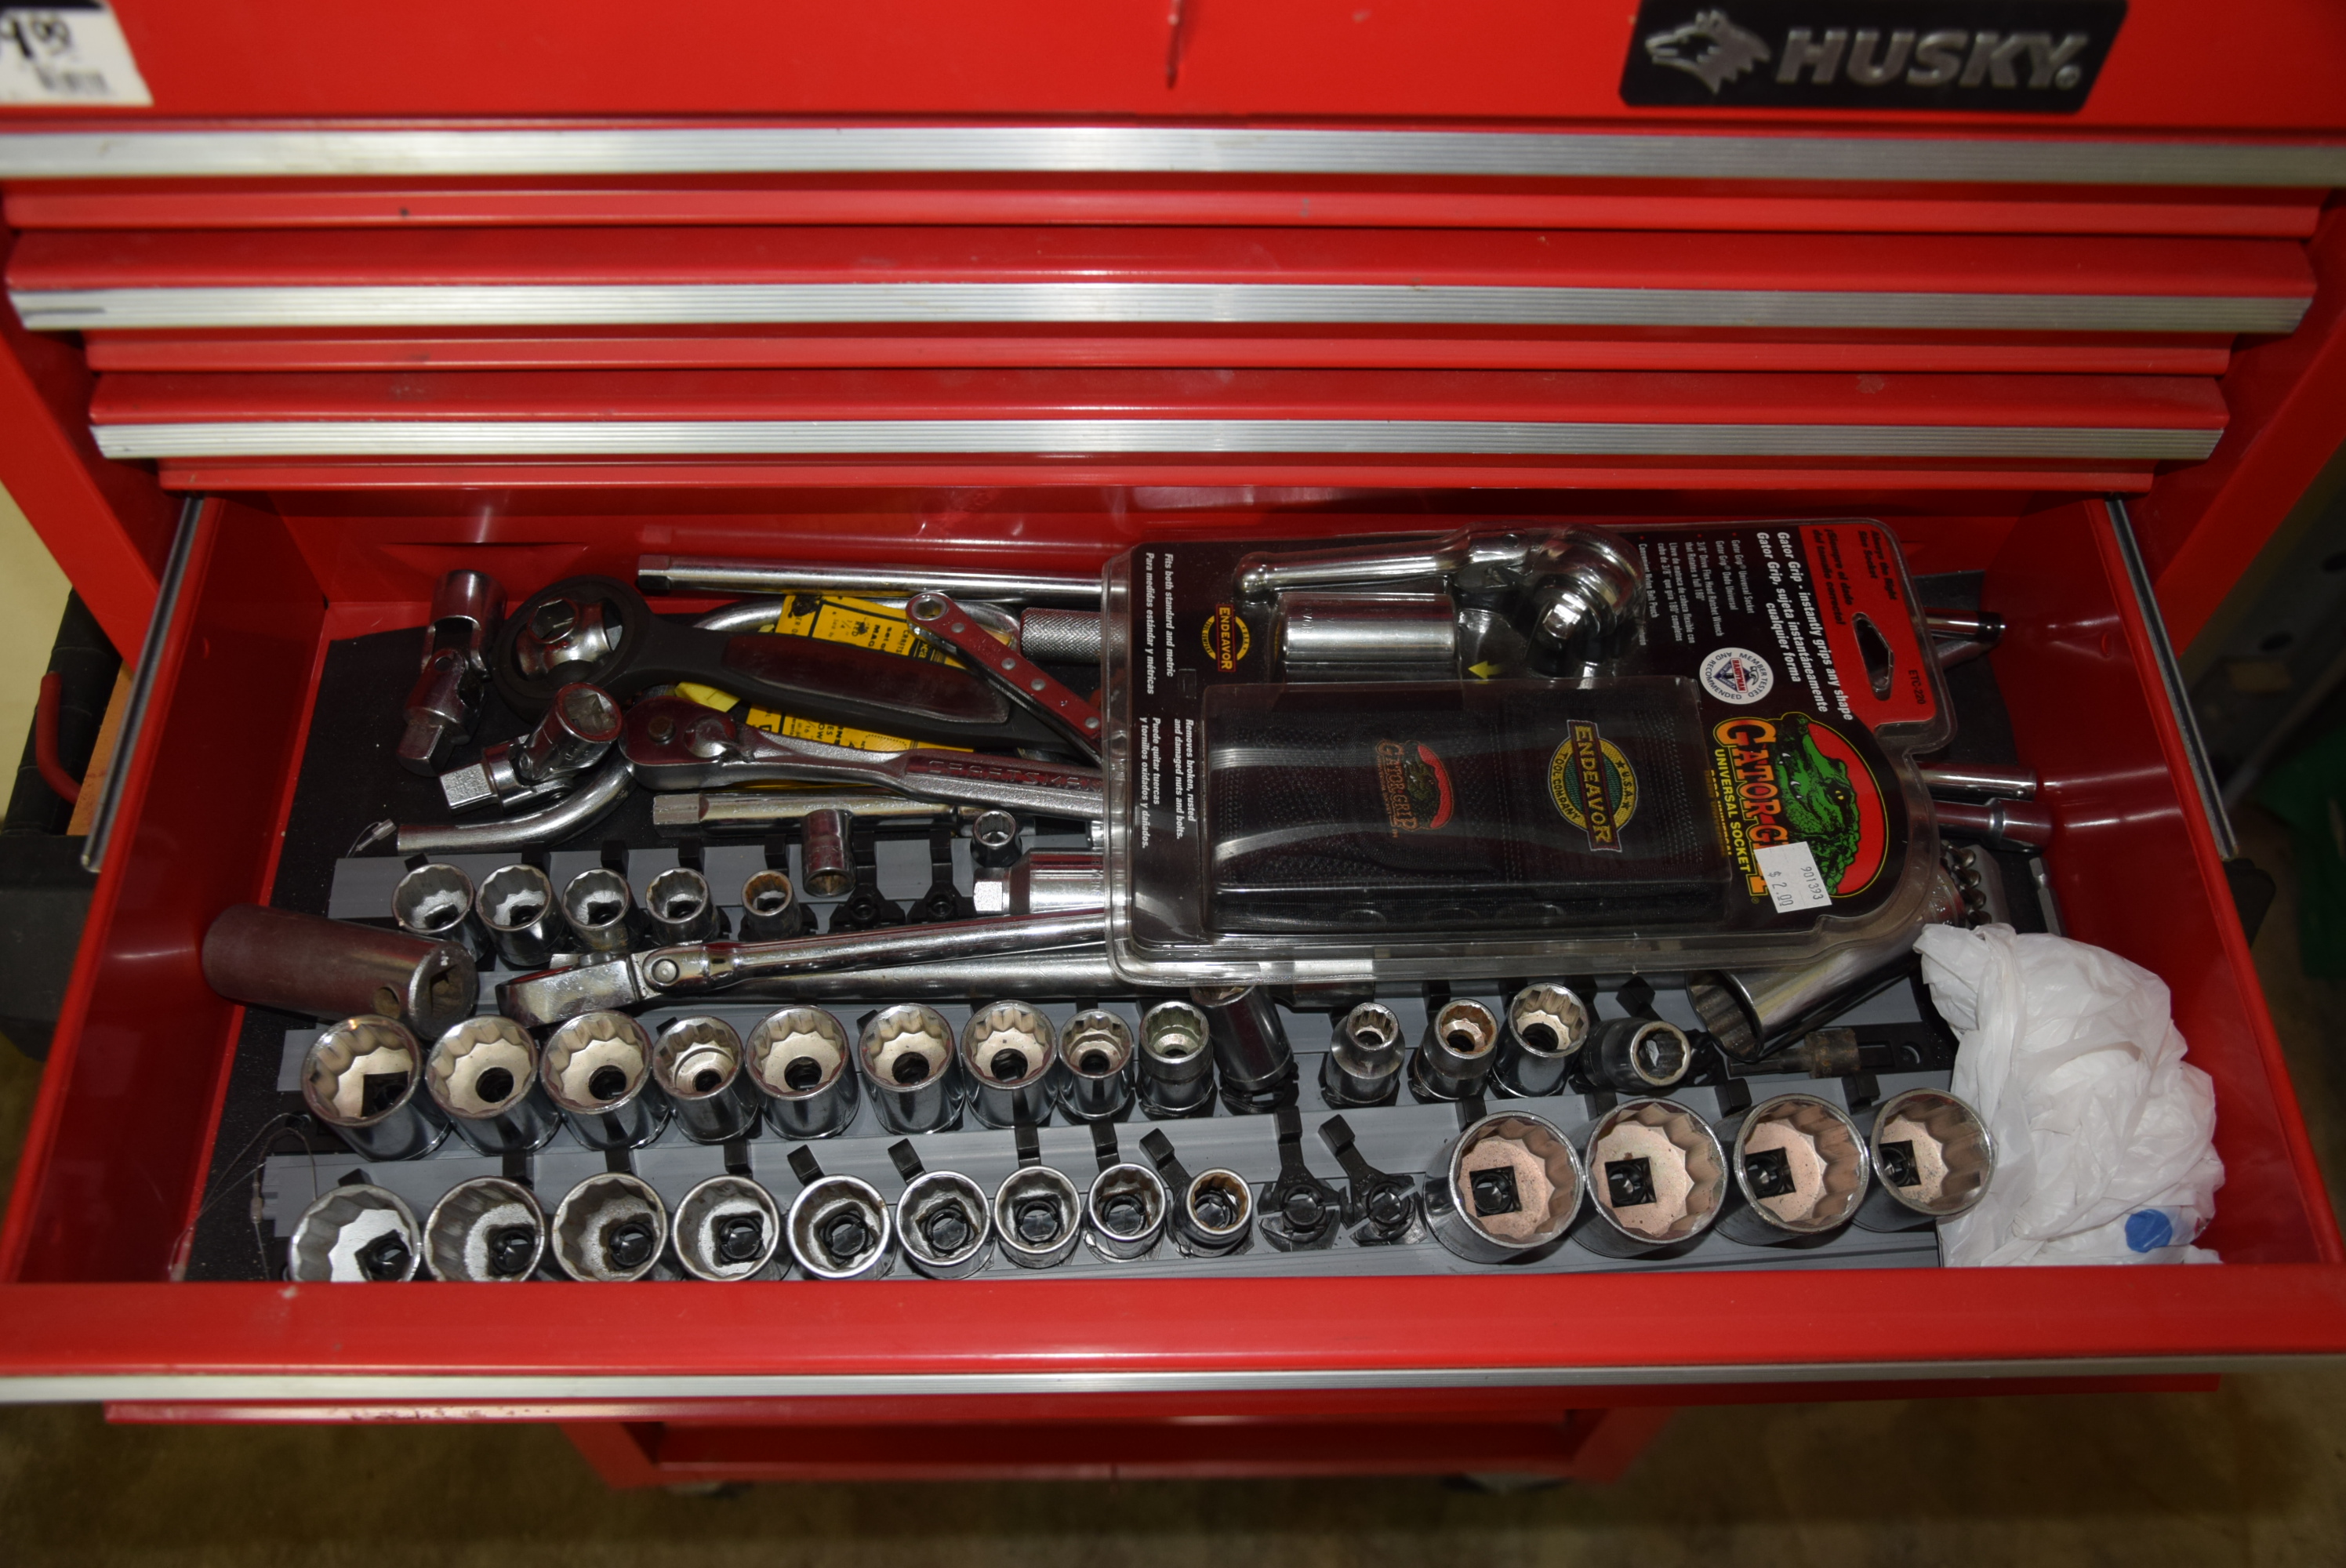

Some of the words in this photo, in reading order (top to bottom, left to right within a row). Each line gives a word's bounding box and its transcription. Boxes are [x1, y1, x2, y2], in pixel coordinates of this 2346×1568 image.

[1774, 27, 2089, 88] HUSKY
[1658, 543, 1667, 555] cubo
[1669, 543, 1680, 557] Llave
[1685, 543, 1694, 552] that
[1716, 541, 1726, 554] Gator
[1731, 540, 1742, 554] Gator
[1146, 553, 1155, 571] Para
[1164, 554, 1174, 568] Fits
[1687, 554, 1698, 572] Rotates
[1701, 554, 1709, 568] Drive
[1863, 550, 1878, 579] Socket
[1165, 571, 1175, 590] both
[1664, 579, 1674, 589] que
[1674, 566, 1684, 586] matraca
[1693, 579, 1702, 587] full
[1705, 581, 1714, 594] Head
[1723, 572, 1732, 584] Dado
[1738, 571, 1752, 595] Universal
[1146, 572, 1156, 607] medidas
[1647, 590, 1658, 601] Belt
[1665, 590, 1676, 600] gira
[1726, 586, 1738, 610] Universal
[1841, 583, 1854, 605] dado
[1165, 592, 1175, 629] standard
[1648, 602, 1660, 618] Pouch
[1680, 595, 1690, 612] cabeza
[1708, 596, 1719, 615] Ratchet
[1744, 596, 1755, 613] Socket
[1146, 610, 1156, 646] estándar
[1672, 615, 1683, 641] completos
[1683, 614, 1695, 633] flexible
[1712, 616, 1724, 636] Wrench
[1756, 532, 1775, 557] Gator
[1767, 562, 1783, 585] Grip,
[1775, 588, 1795, 619] sujeta
[1788, 622, 1828, 712] instantáneamente
[1777, 532, 1795, 557] Gator
[1788, 561, 1803, 582] Grip
[1798, 592, 1823, 636] instantly
[1813, 639, 1833, 665] grips
[1825, 668, 1840, 686] any
[1833, 690, 1854, 720] shape
[1166, 630, 1175, 647] and
[1219, 607, 1233, 670] ENDEAVOR
[1687, 634, 1696, 644] con
[1765, 603, 1790, 650] cualquier
[1782, 652, 1802, 682] forma
[1166, 648, 1175, 677] metric
[1739, 653, 1767, 677] MEMBER
[1146, 656, 1157, 695] métricas
[1705, 660, 1741, 699] RECOMMENDED
[1732, 660, 1745, 691] HANDYMAN
[1908, 670, 1926, 704] ETC-220
[1748, 678, 1767, 698] TESTED
[1141, 725, 1149, 760] tornillos
[1153, 717, 1161, 744] Puede
[1186, 719, 1194, 757] Removes
[1151, 746, 1161, 771] quitar
[1173, 736, 1183, 775] damaged
[1553, 752, 1568, 777] TOOL
[1141, 762, 1150, 800] oxidados
[1186, 760, 1195, 791] broken,
[1716, 720, 1781, 818] GATOR
[1575, 725, 1613, 844] ENDEAVOR
[1176, 797, 1185, 813] and
[1187, 793, 1197, 822] rusted
[1553, 779, 1580, 820] COMPANY
[1714, 748, 1738, 818] UNIVERSAL
[1730, 822, 1751, 872] SOCKET
[1142, 811, 1150, 848] dañados.
[1176, 815, 1185, 840] bolts.
[1800, 866, 1824, 900] 901393
